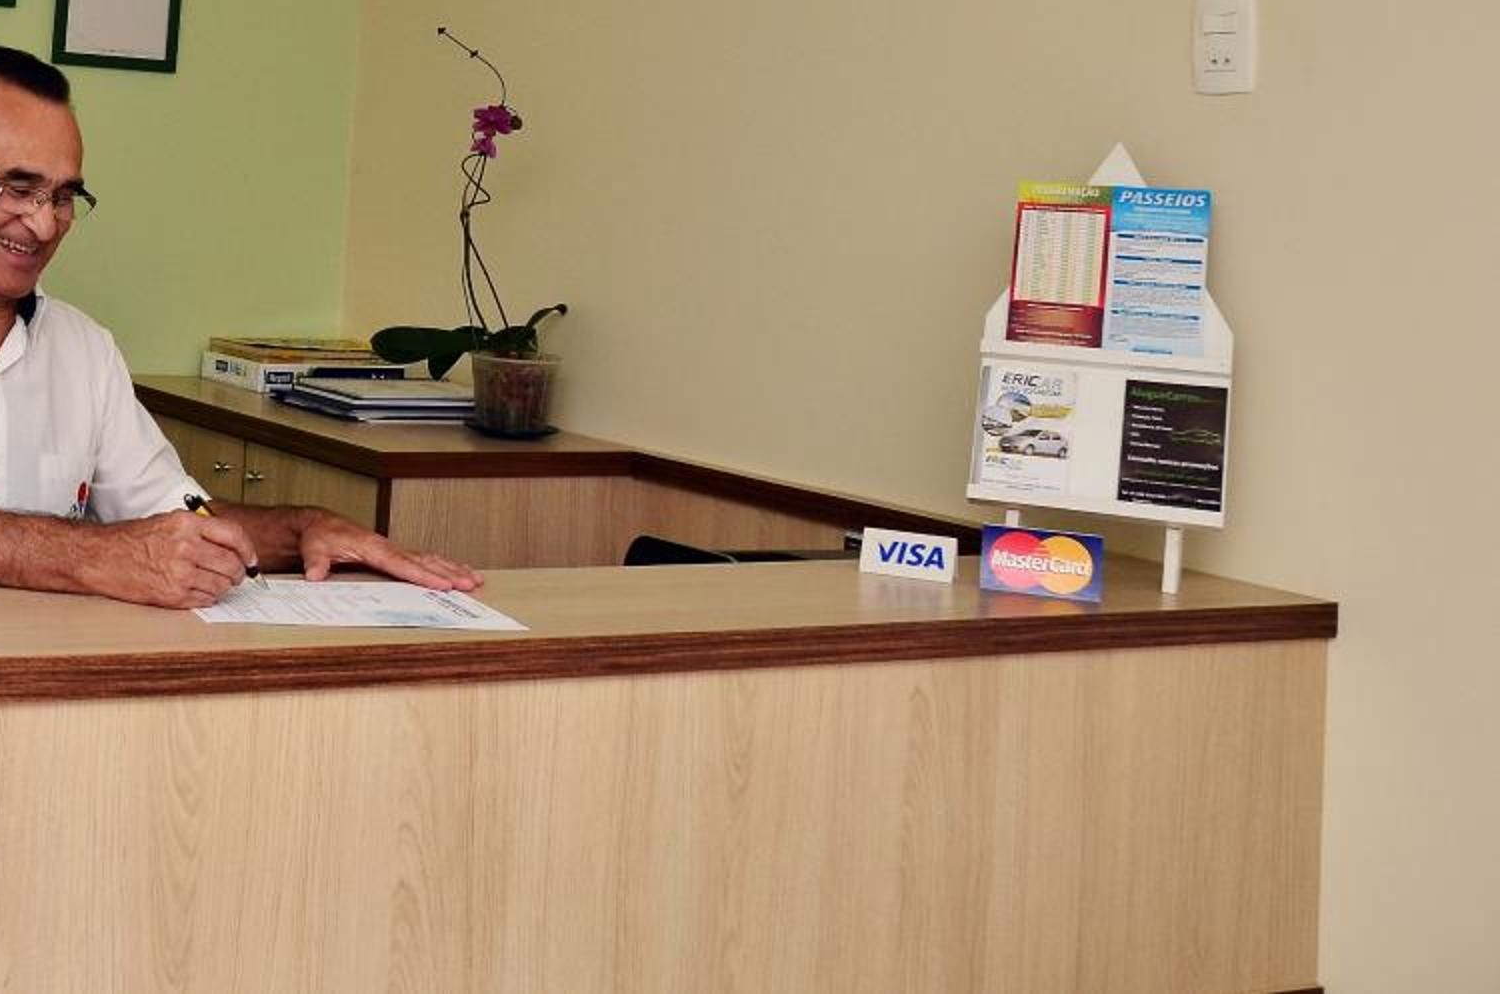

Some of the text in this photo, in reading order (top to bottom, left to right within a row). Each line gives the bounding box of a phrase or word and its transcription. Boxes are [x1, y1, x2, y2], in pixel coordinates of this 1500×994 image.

[1119, 190, 1206, 206] PASSEIOS
[878, 541, 945, 570] VISA
[992, 549, 1092, 577] MasterCard
